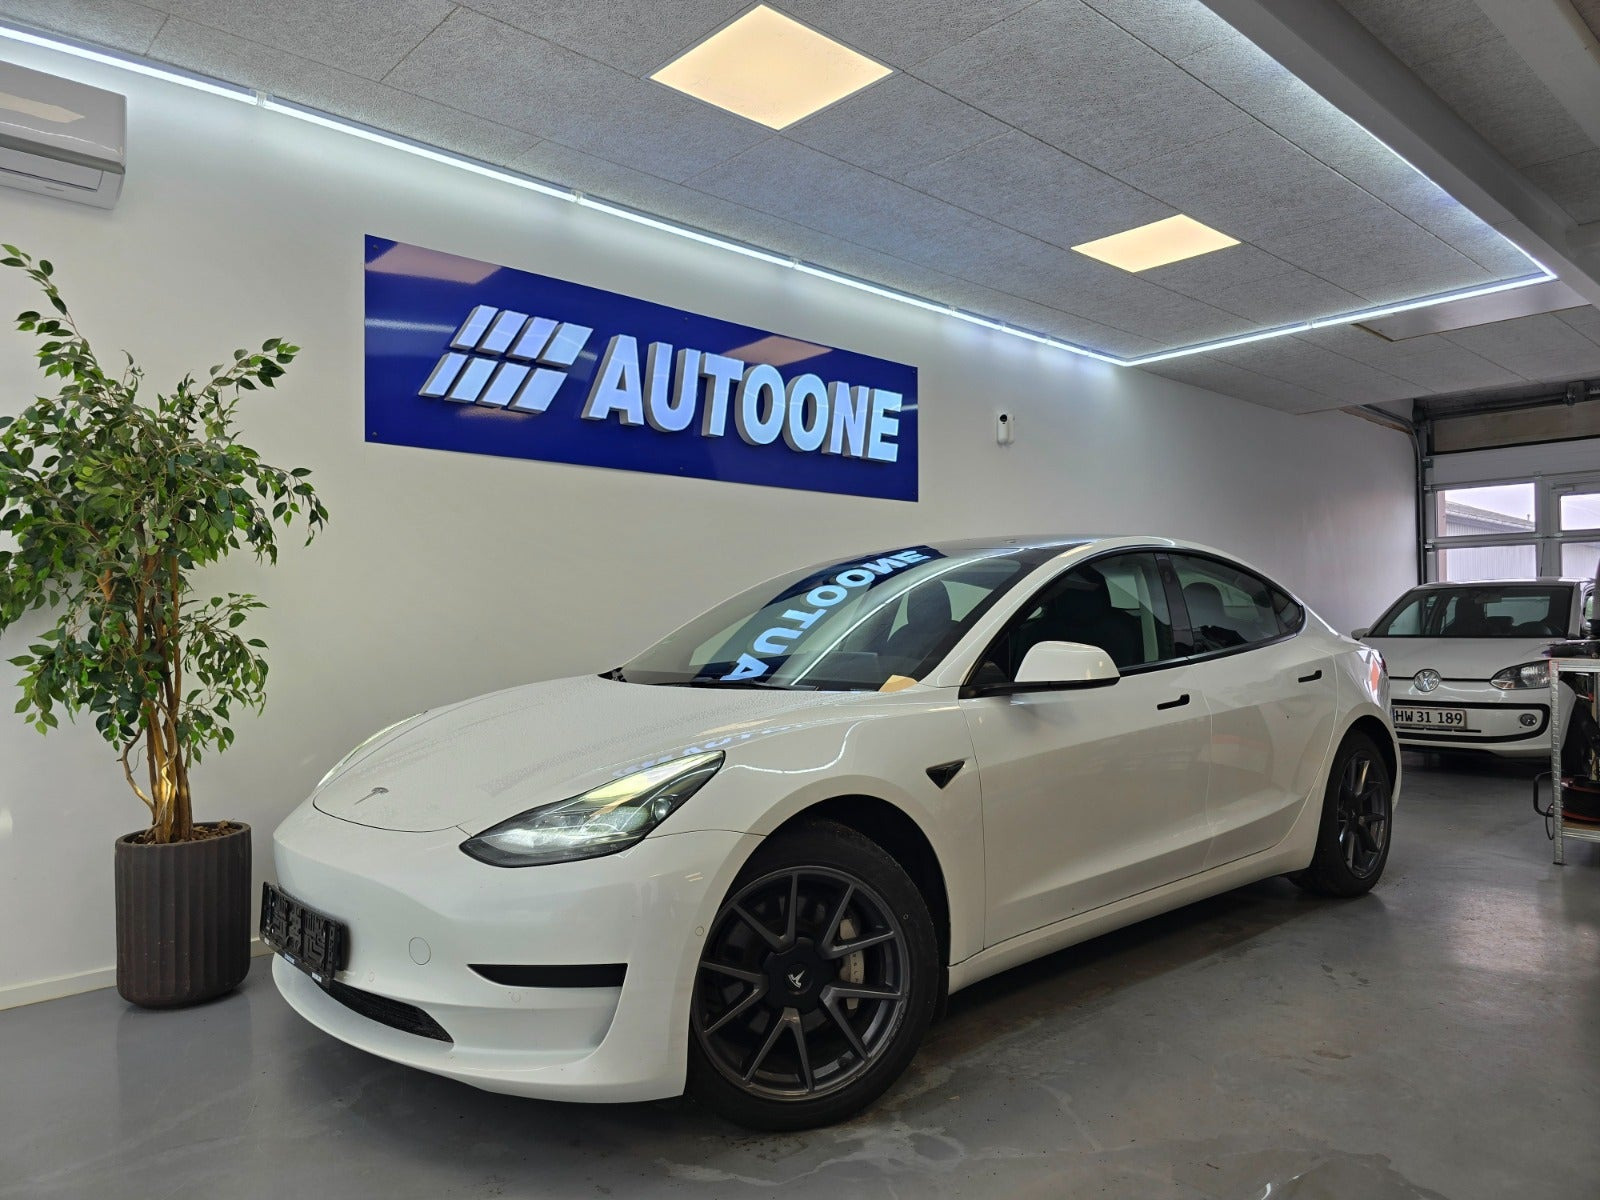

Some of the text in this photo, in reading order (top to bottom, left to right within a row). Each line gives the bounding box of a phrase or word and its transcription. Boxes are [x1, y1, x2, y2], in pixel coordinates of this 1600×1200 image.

[581, 334, 903, 463] AUTOONE
[1395, 710, 1463, 725] HW 31 189
